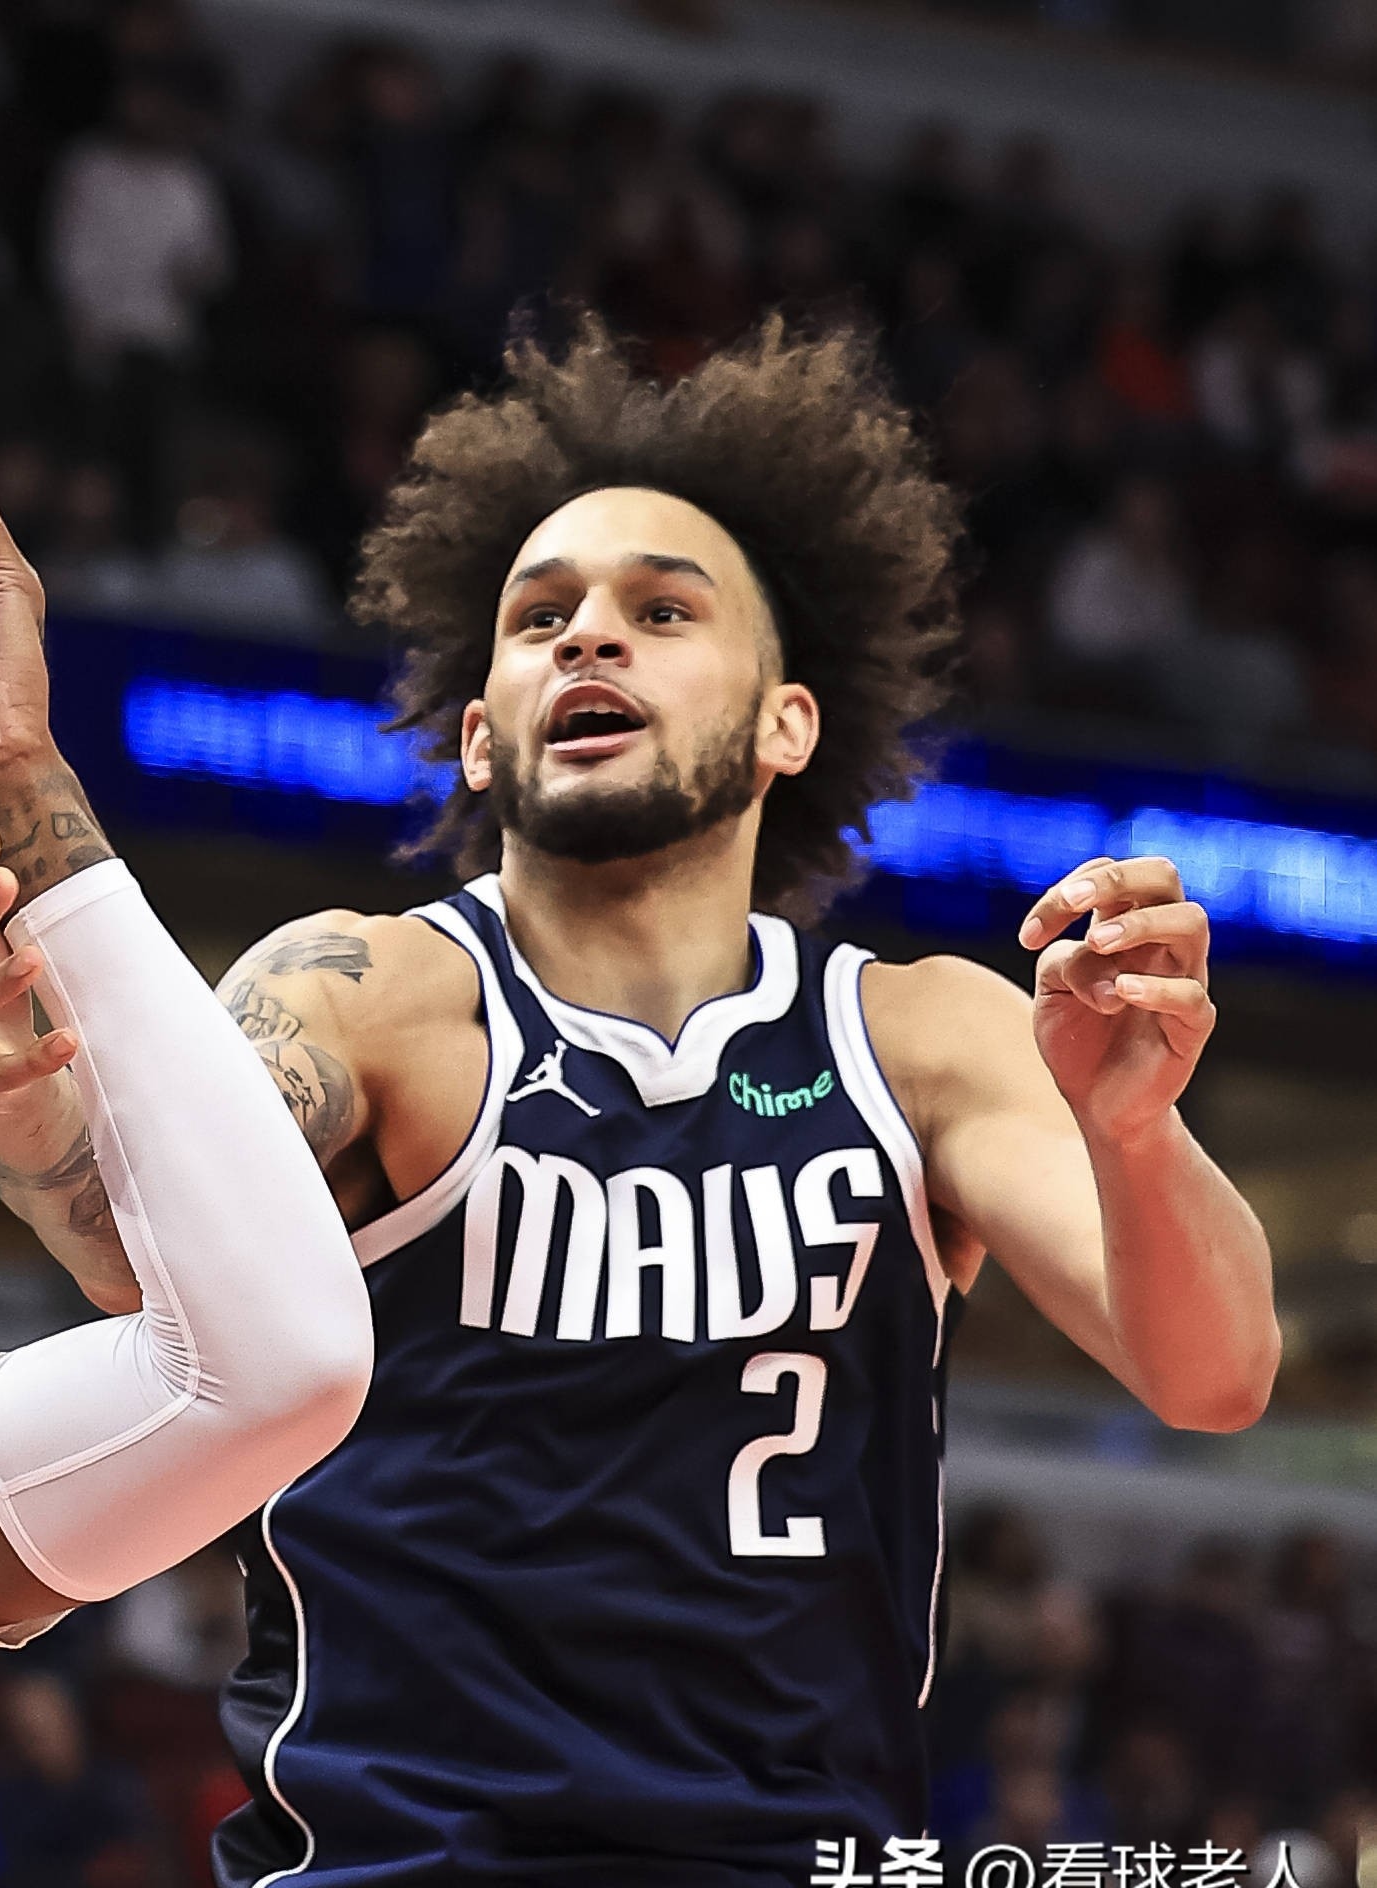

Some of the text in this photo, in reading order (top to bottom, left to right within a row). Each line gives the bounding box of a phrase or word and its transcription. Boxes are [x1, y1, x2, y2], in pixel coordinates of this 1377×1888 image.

[729, 1070, 835, 1117] Chime
[459, 1145, 884, 1343] MAVS
[727, 1352, 828, 1558] 2
